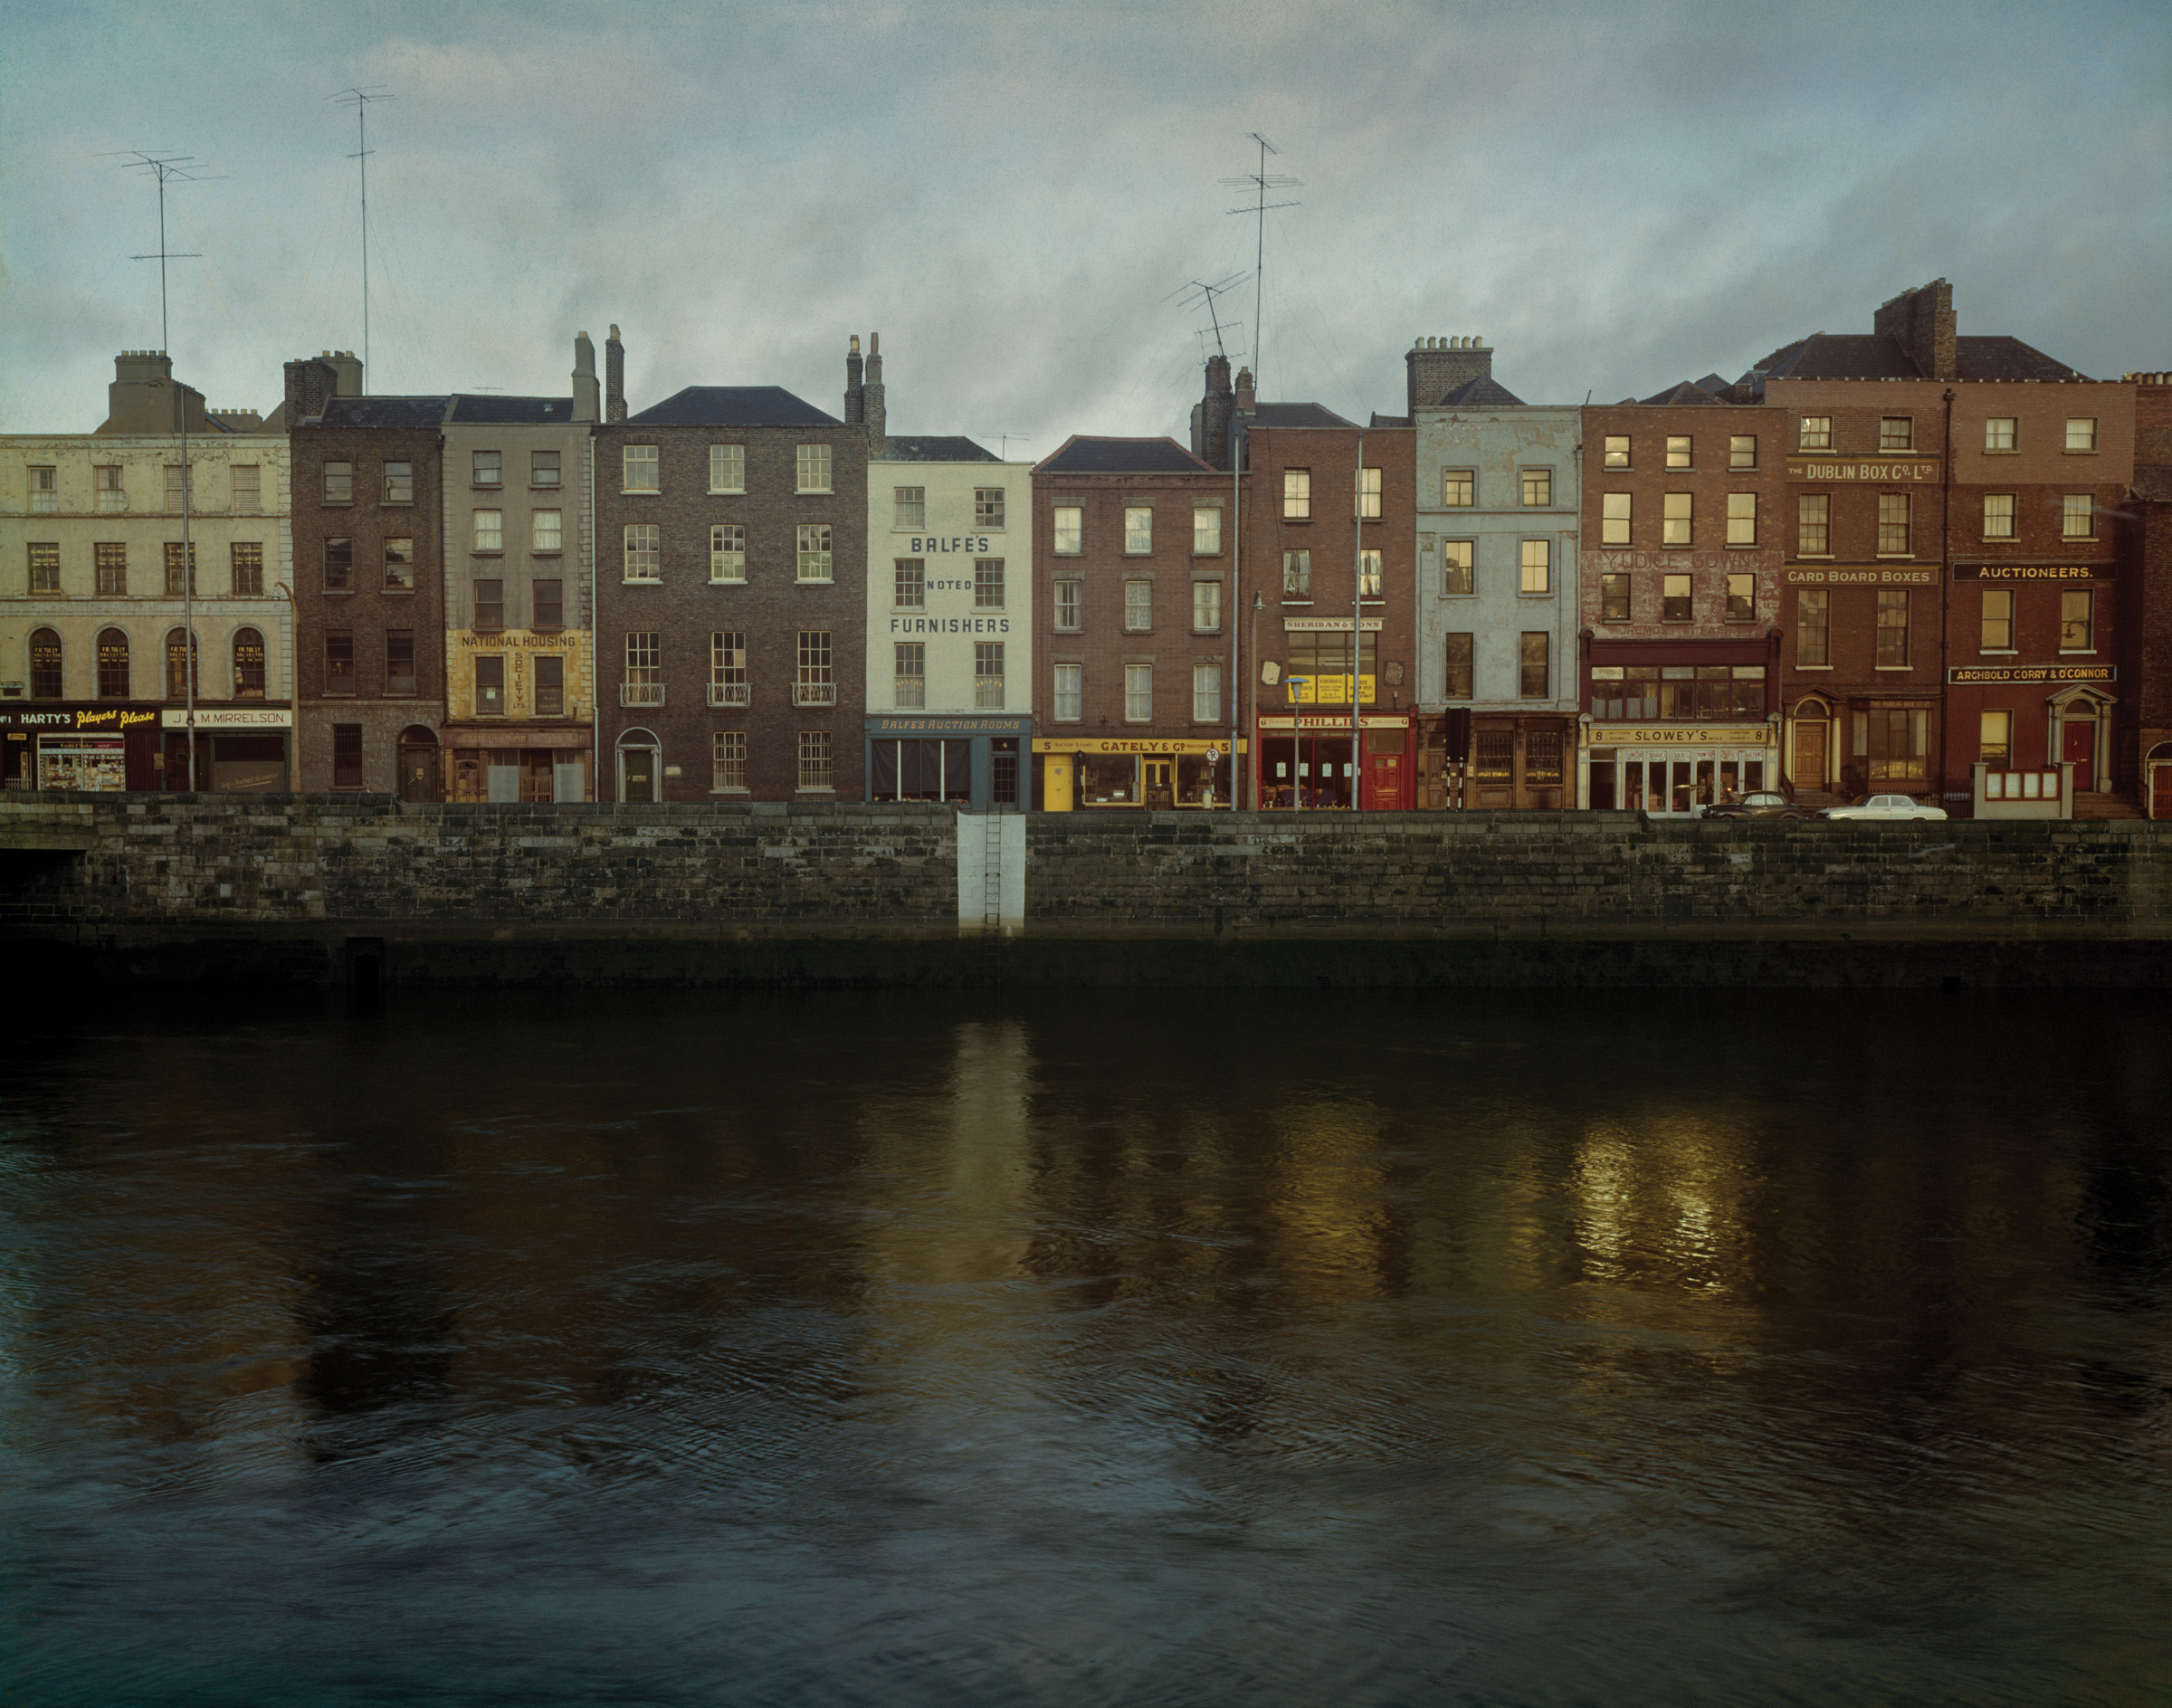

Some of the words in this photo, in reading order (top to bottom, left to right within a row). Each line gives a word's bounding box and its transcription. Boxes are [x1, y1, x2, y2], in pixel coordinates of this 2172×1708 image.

[1807, 464, 1855, 479] DUBLIN
[1860, 464, 1889, 479] BOX
[911, 536, 988, 552] BALFE'S
[1788, 571, 1825, 582] CARD
[1829, 571, 1877, 582] BOARD
[1881, 571, 1930, 582] BOXES
[927, 580, 972, 589] NOTED
[891, 619, 1009, 633] FURNISHERS
[462, 636, 520, 646] NATIONAL
[523, 636, 576, 646] HOUSING
[514, 652, 524, 701] SOCIETY
[1957, 671, 2010, 681] ARCHBOLD
[2014, 670, 2047, 680] CORRY
[2050, 669, 2057, 679] &
[2058, 668, 2109, 679] O'CONNOR
[22, 713, 71, 724] HARTY'S
[77, 710, 117, 729] Players
[120, 711, 155, 729] Please
[174, 713, 181, 722] J
[201, 713, 210, 722] M
[214, 713, 284, 723] MIRRELSON
[882, 720, 925, 730] BALFE'S
[928, 720, 978, 730] AUCTION
[980, 720, 1020, 730] ROOMS
[1596, 731, 1603, 740] 8
[1634, 730, 1708, 740] SLOWEY'S
[1756, 730, 1763, 740] 8
[1044, 742, 1052, 750] 5
[1101, 742, 1158, 751] GATELY
[1162, 742, 1168, 751] &
[1221, 742, 1229, 751] 5
[1908, 766, 1923, 776] BOX
